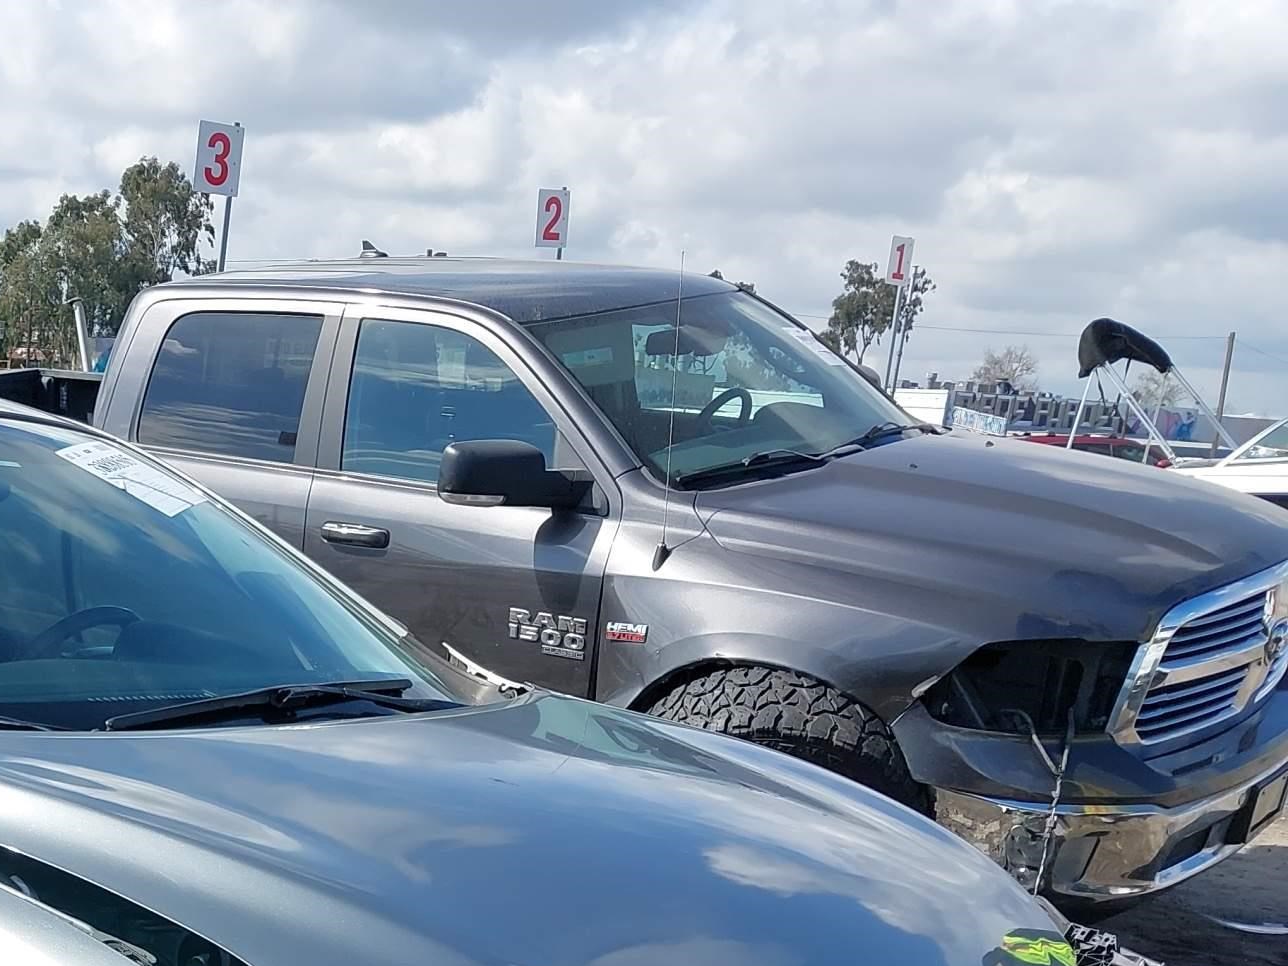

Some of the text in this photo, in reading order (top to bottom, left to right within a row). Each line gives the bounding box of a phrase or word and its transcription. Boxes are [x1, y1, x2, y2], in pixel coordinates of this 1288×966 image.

[204, 132, 231, 187] 3
[542, 196, 562, 241] 2
[892, 243, 905, 280] 1
[508, 607, 588, 635] RAM
[508, 623, 586, 651] 1500
[606, 621, 649, 635] HEMI
